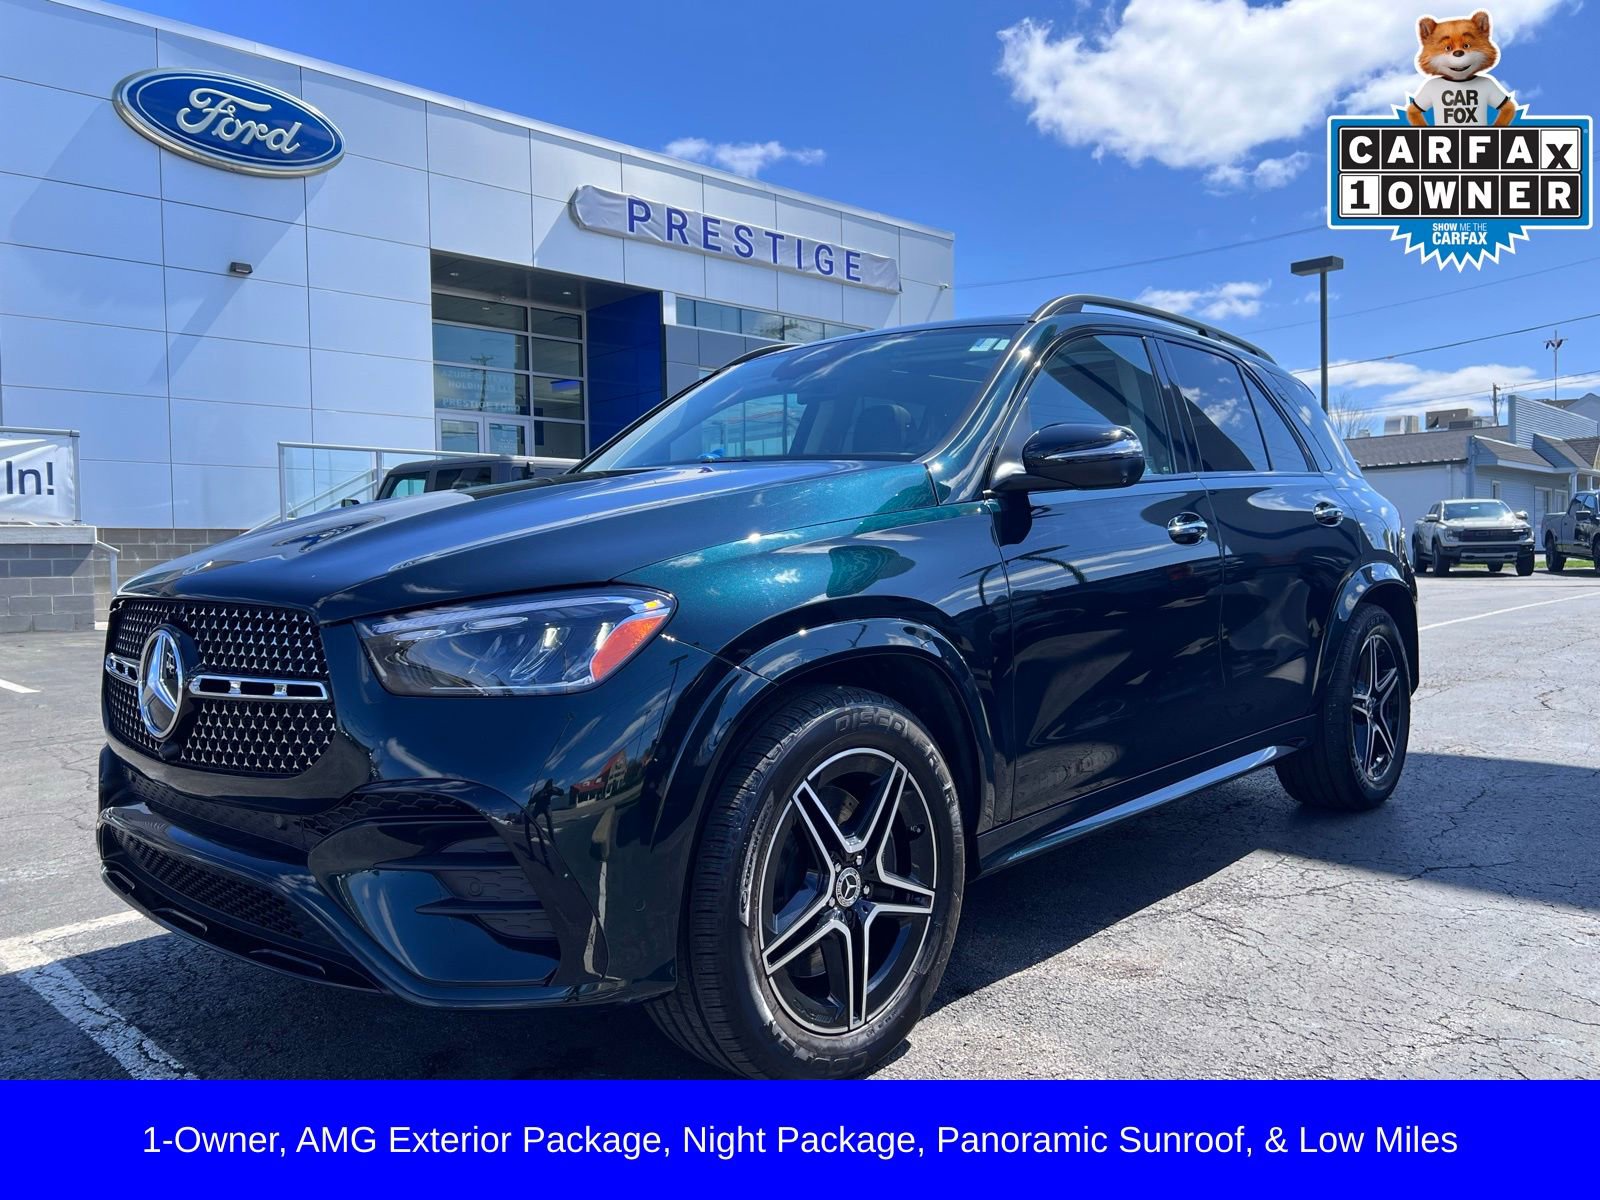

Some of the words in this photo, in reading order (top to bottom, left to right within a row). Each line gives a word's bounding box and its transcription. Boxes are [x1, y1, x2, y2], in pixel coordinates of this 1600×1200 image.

[176, 87, 302, 154] Ford
[627, 197, 861, 282] PRESTIGE
[6, 461, 54, 495] In!
